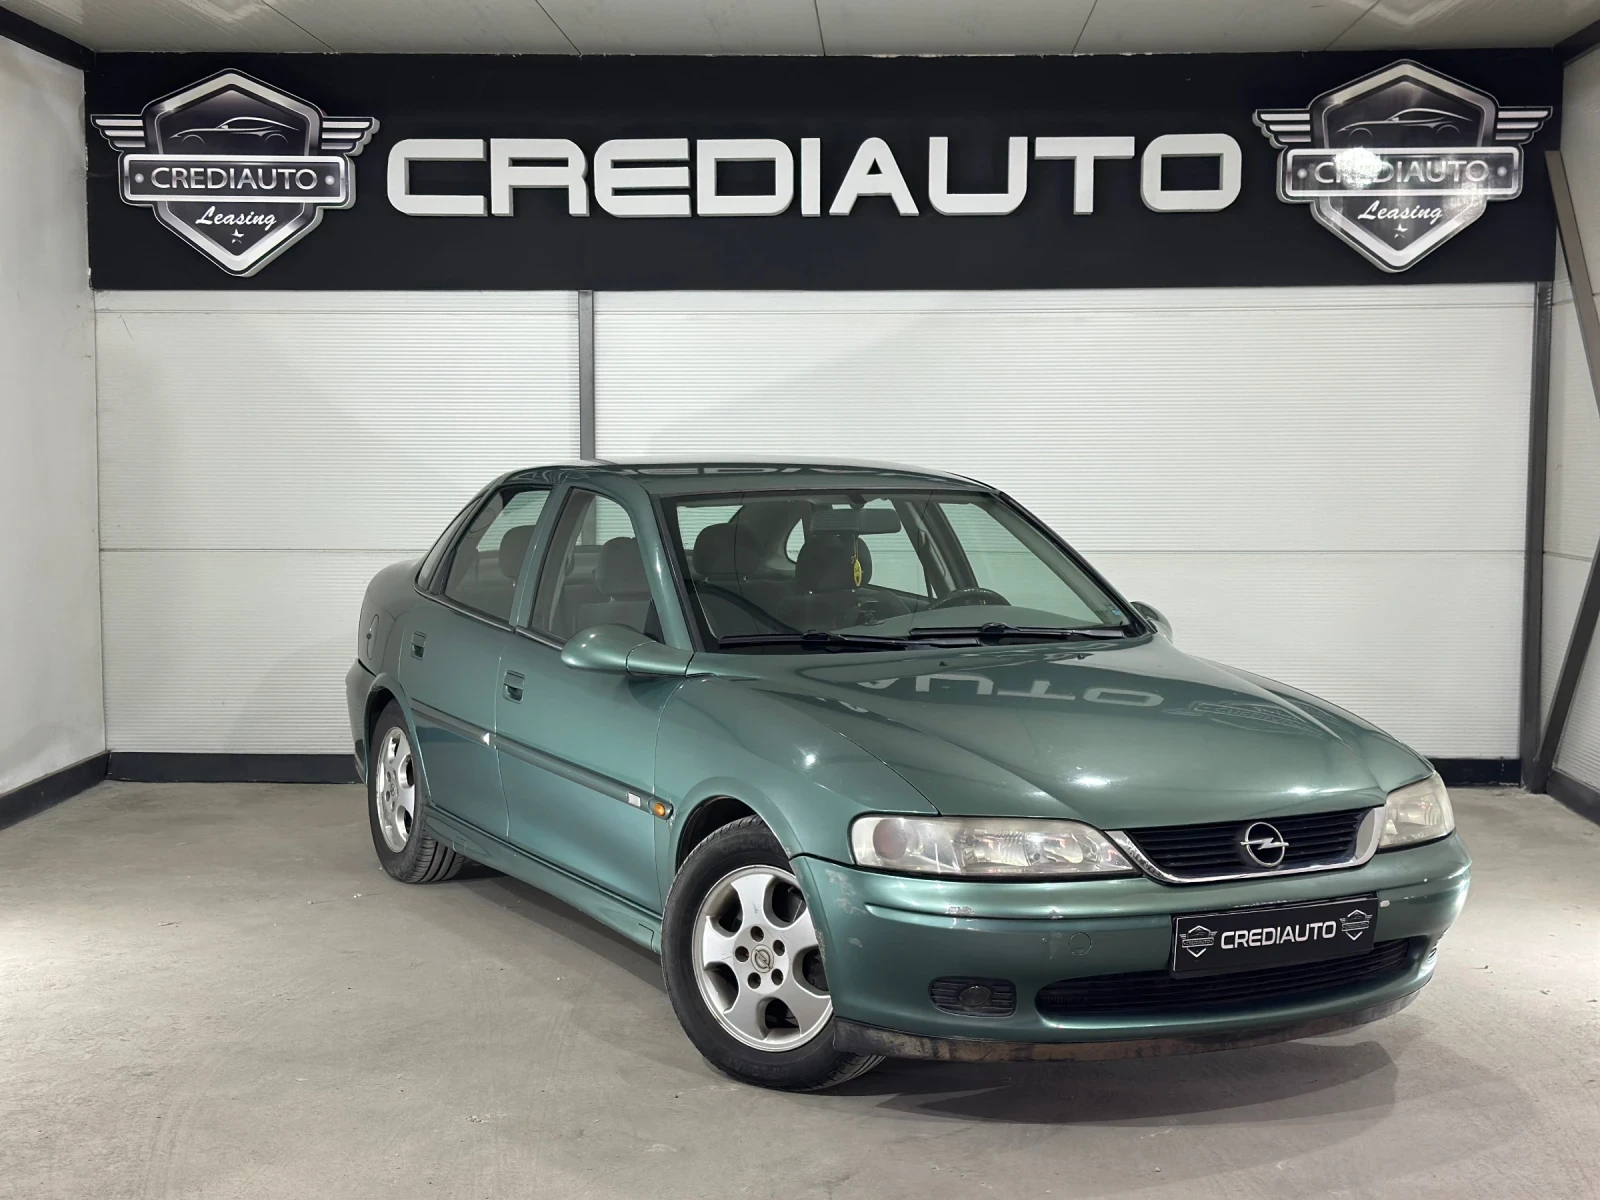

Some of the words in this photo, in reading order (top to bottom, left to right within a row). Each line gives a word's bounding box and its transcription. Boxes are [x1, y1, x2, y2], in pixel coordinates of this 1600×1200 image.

[150, 166, 318, 190] CREDIAUTO
[387, 133, 1243, 217] CREDIAUTO
[1314, 159, 1490, 184] CDIAUTO
[195, 205, 277, 231] Leasing
[1357, 199, 1443, 225] Leasing
[1220, 920, 1337, 950] CREDIAUTO
